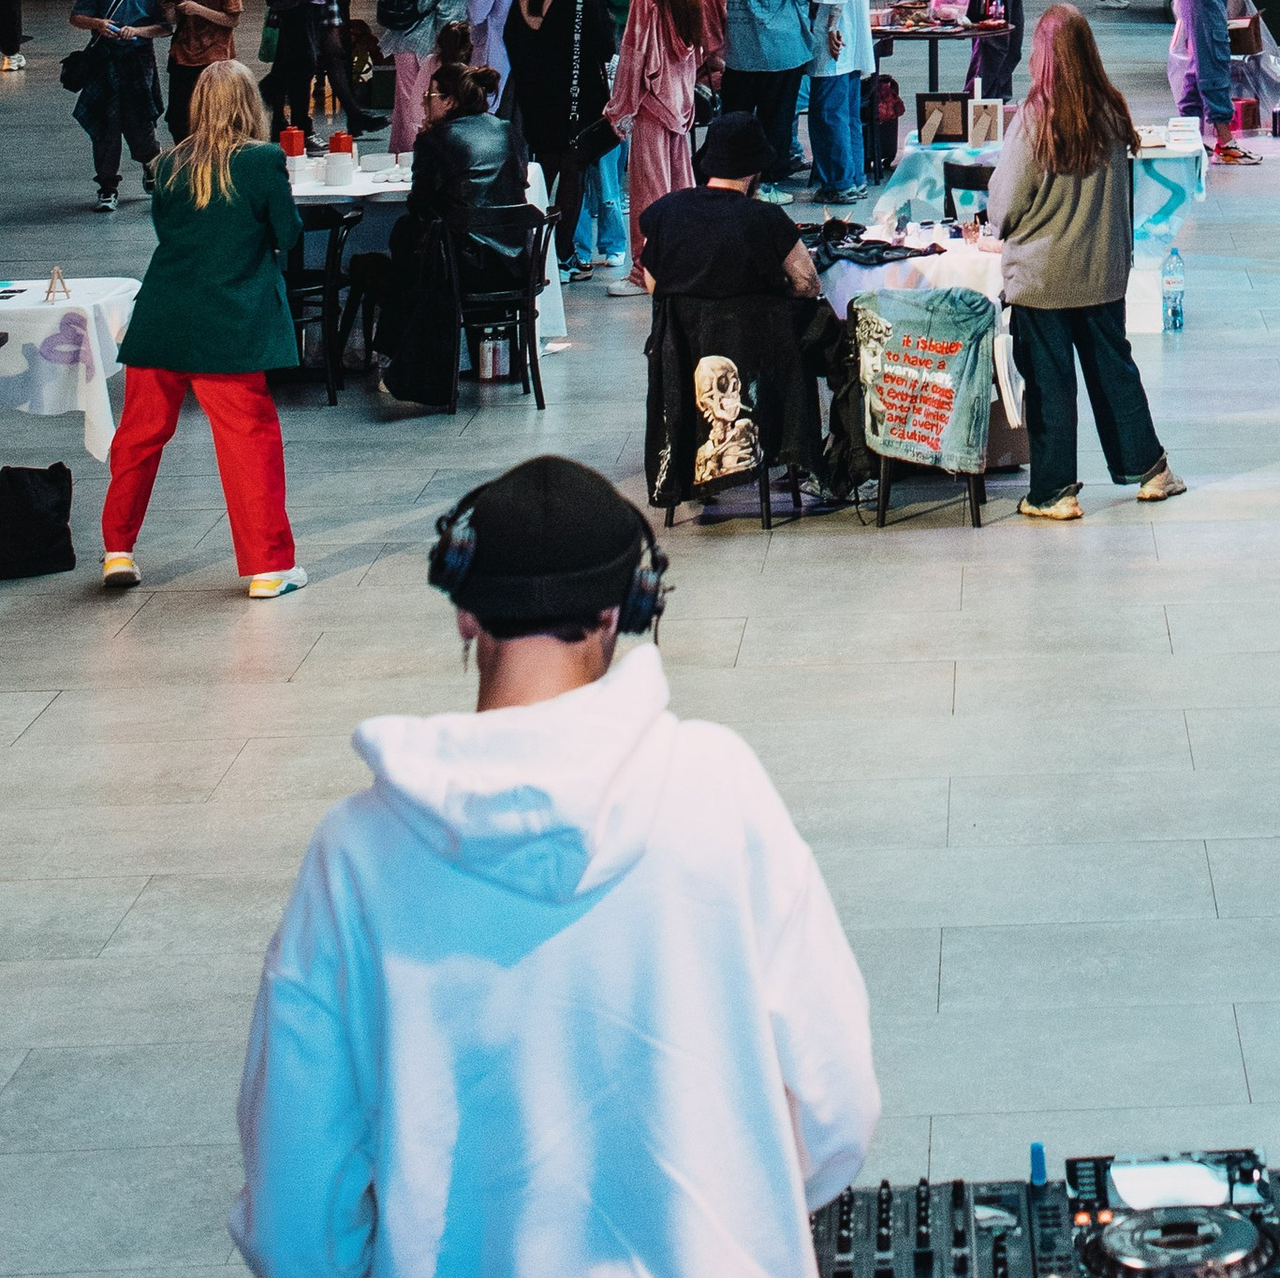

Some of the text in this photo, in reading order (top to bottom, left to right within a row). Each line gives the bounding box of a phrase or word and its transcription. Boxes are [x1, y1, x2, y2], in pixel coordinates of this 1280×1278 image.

[902, 334, 912, 347] it
[916, 336, 927, 351] is
[885, 350, 946, 370] to have a
[883, 364, 920, 379] warm
[883, 373, 908, 387] even
[909, 379, 919, 391] if
[921, 381, 930, 392] it
[886, 388, 918, 404] extra
[898, 404, 911, 413] to
[912, 405, 922, 415] be
[886, 413, 944, 436] and overly
